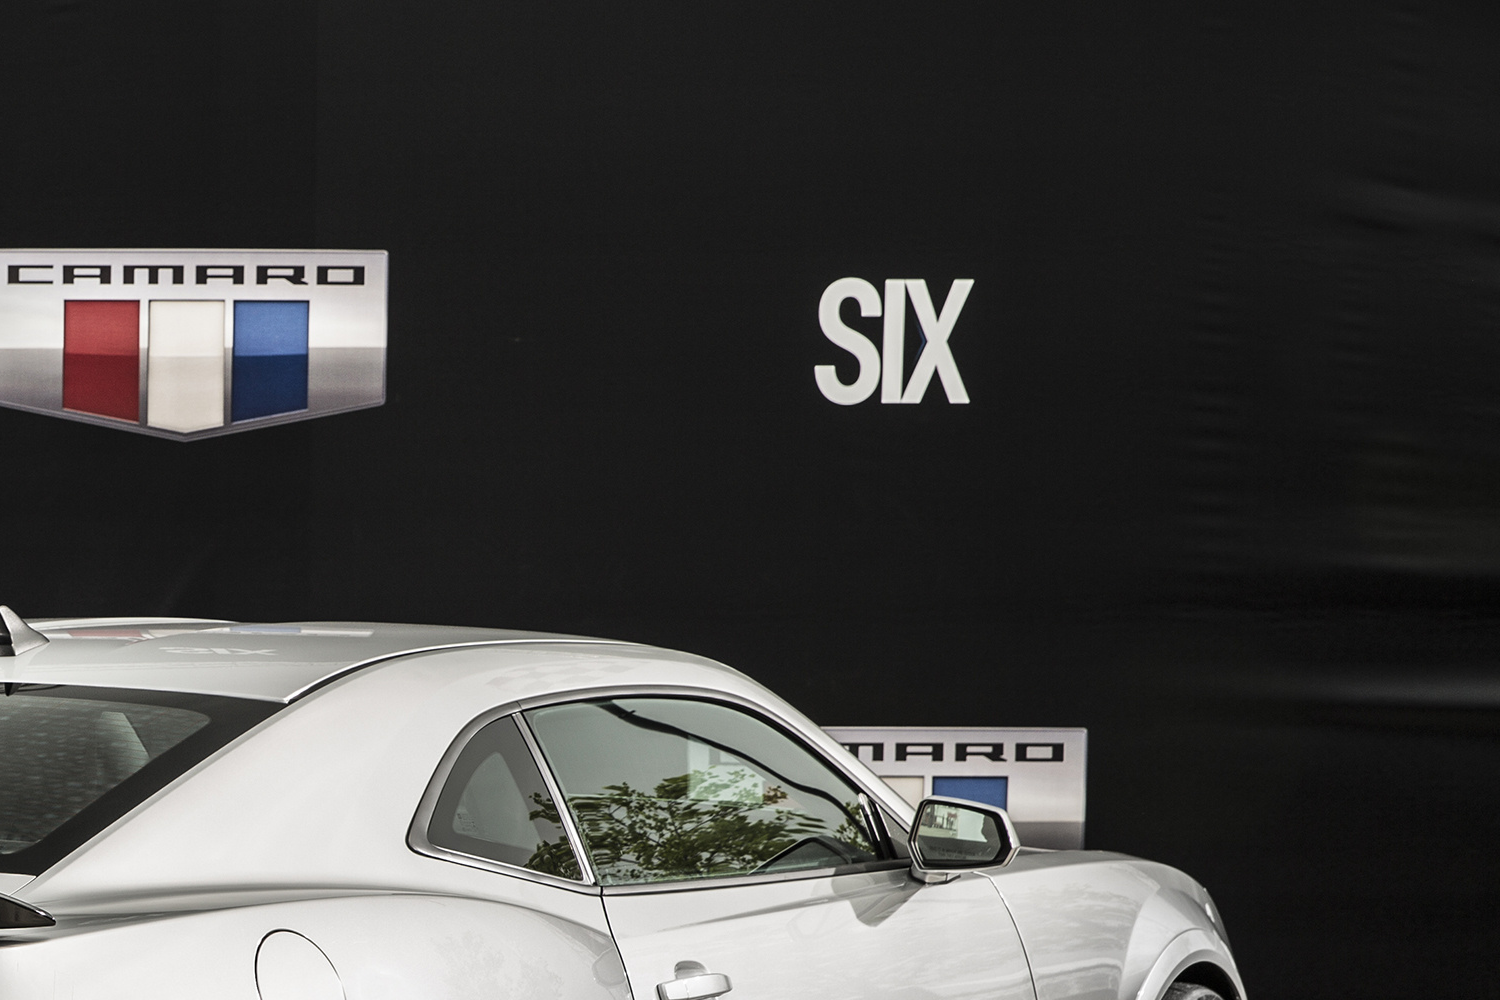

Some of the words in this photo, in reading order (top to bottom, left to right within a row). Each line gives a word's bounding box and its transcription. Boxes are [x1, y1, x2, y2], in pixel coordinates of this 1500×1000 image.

[7, 264, 366, 286] CAMARO
[813, 276, 975, 406] SIX
[840, 742, 1065, 762] MARO
